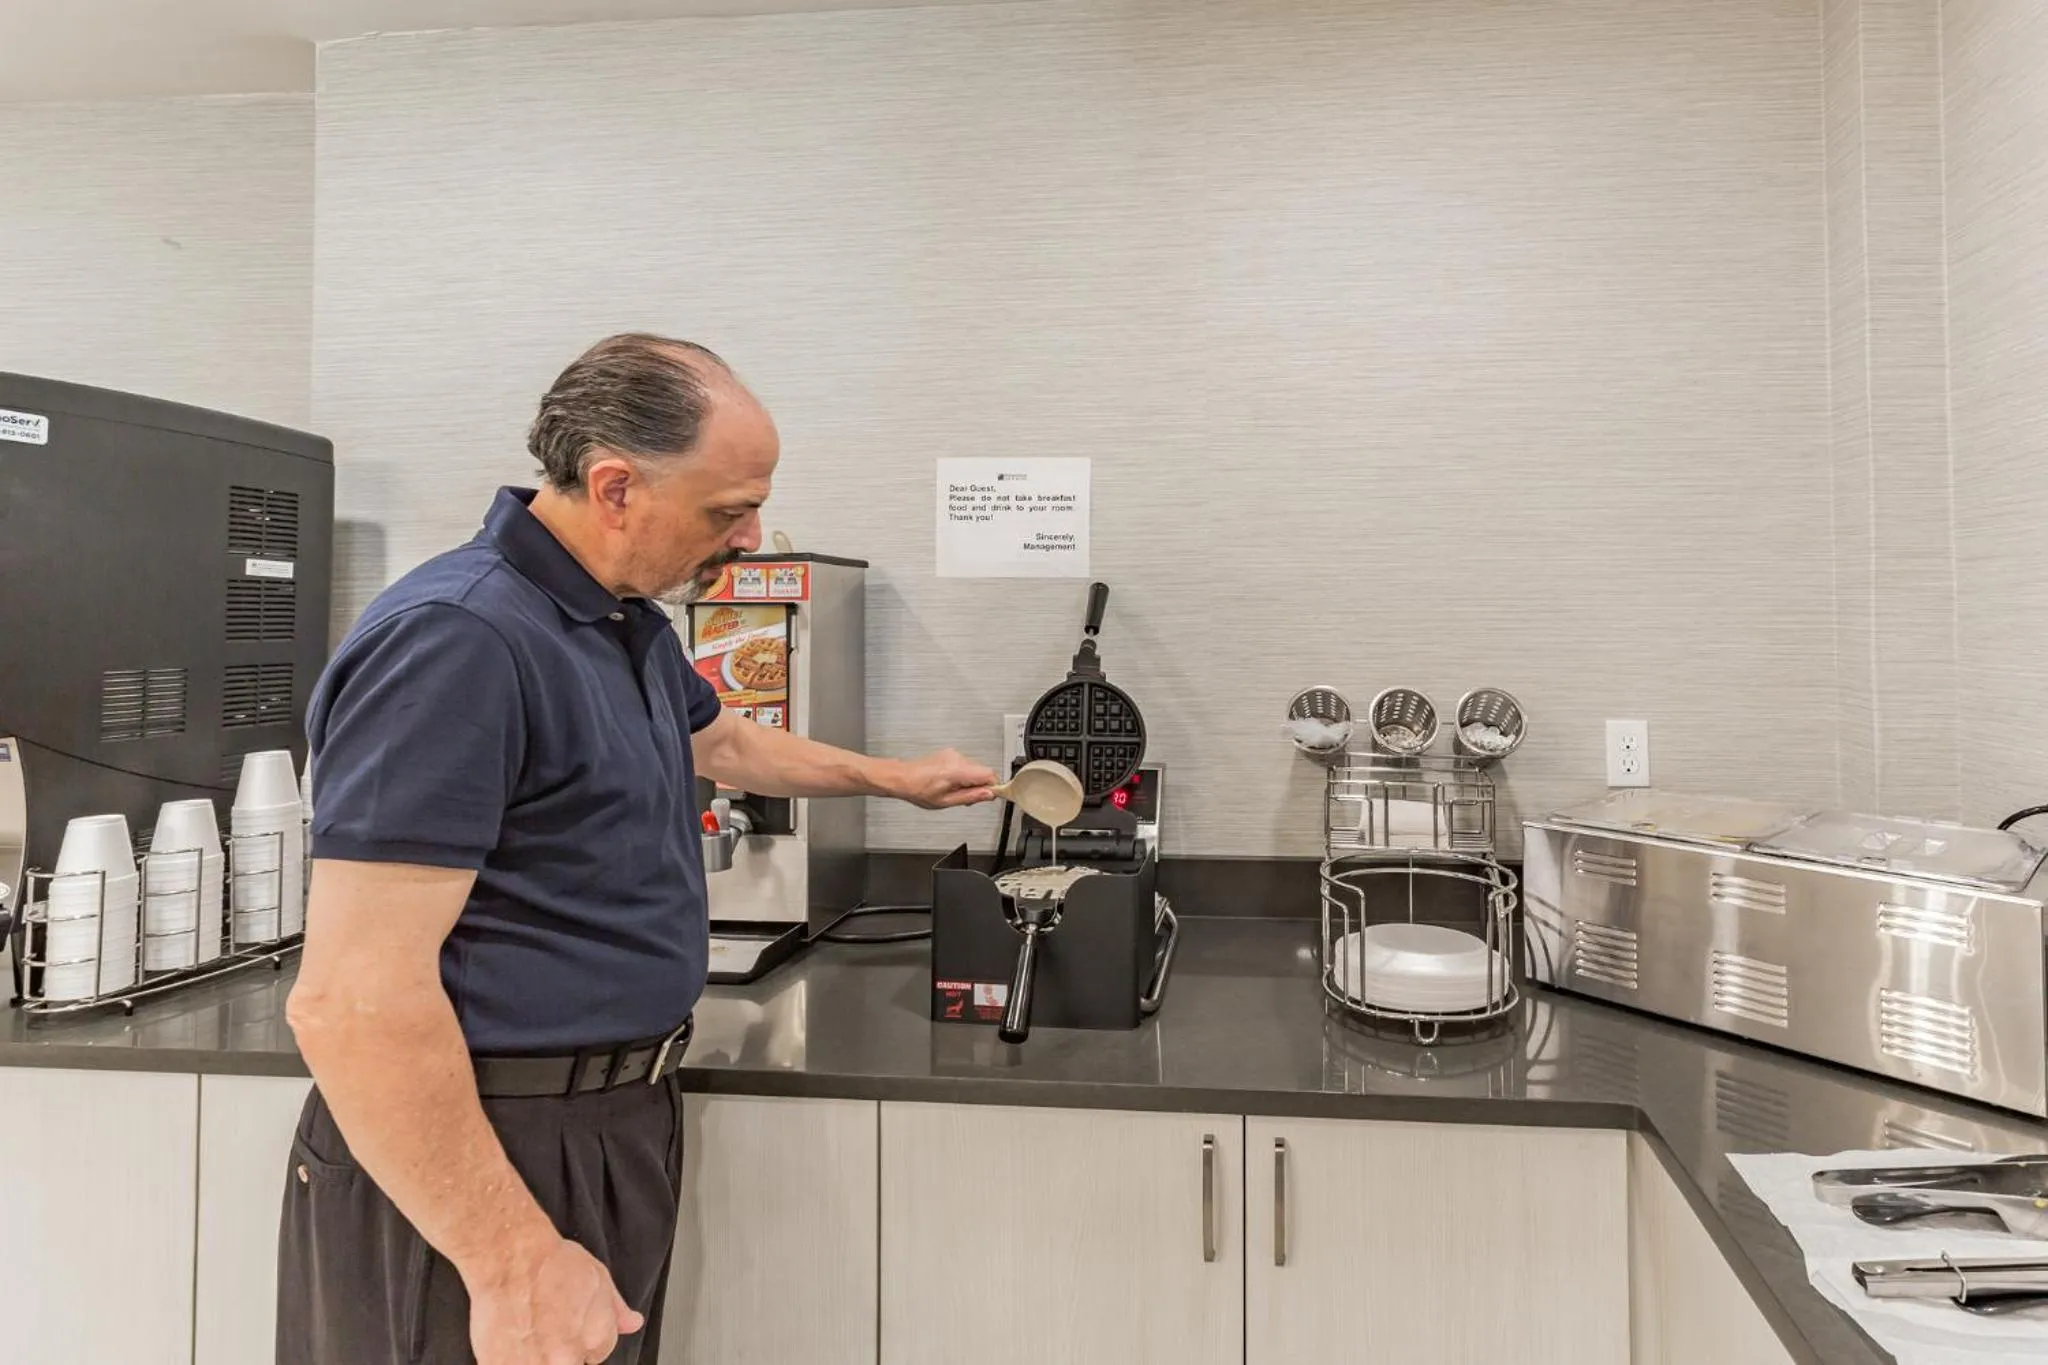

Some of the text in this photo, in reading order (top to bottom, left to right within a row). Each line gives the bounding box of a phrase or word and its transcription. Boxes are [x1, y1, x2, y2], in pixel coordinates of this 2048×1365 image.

[949, 484, 968, 492] Dear
[949, 494, 975, 502] Please
[981, 494, 992, 502] do
[1015, 494, 1033, 502] take
[1037, 494, 1076, 502] breakfast
[949, 504, 968, 512] food
[971, 504, 987, 512] and
[991, 504, 1012, 512] drink
[1016, 504, 1025, 512] to
[1029, 505, 1047, 513] your
[975, 514, 994, 523] you!
[1035, 532, 1076, 542] Sincerely,
[1023, 542, 1076, 552] Management
[936, 981, 972, 990] CAUTION
